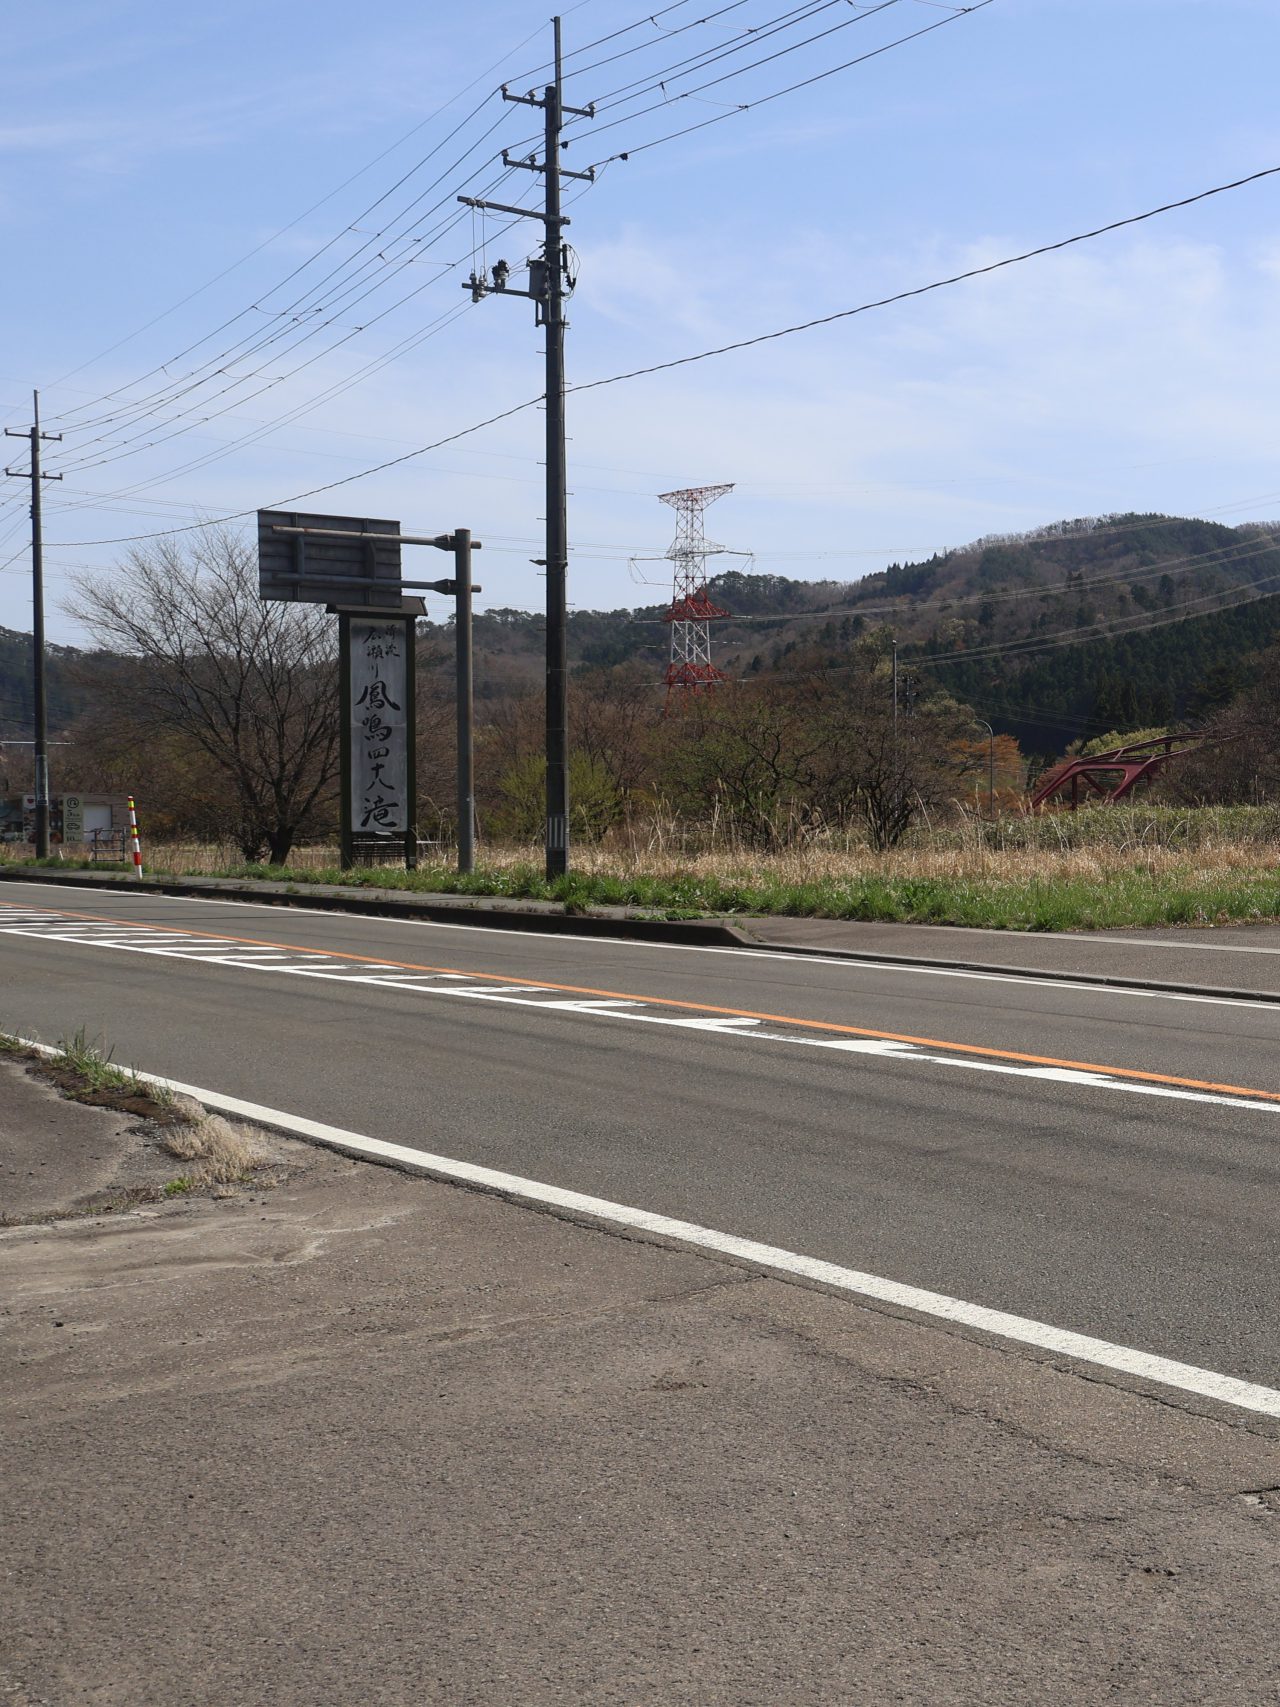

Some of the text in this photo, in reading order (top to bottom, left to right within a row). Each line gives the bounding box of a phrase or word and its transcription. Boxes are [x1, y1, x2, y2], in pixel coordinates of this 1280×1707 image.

[355, 680, 401, 828] 鳳鳴四十八滝
